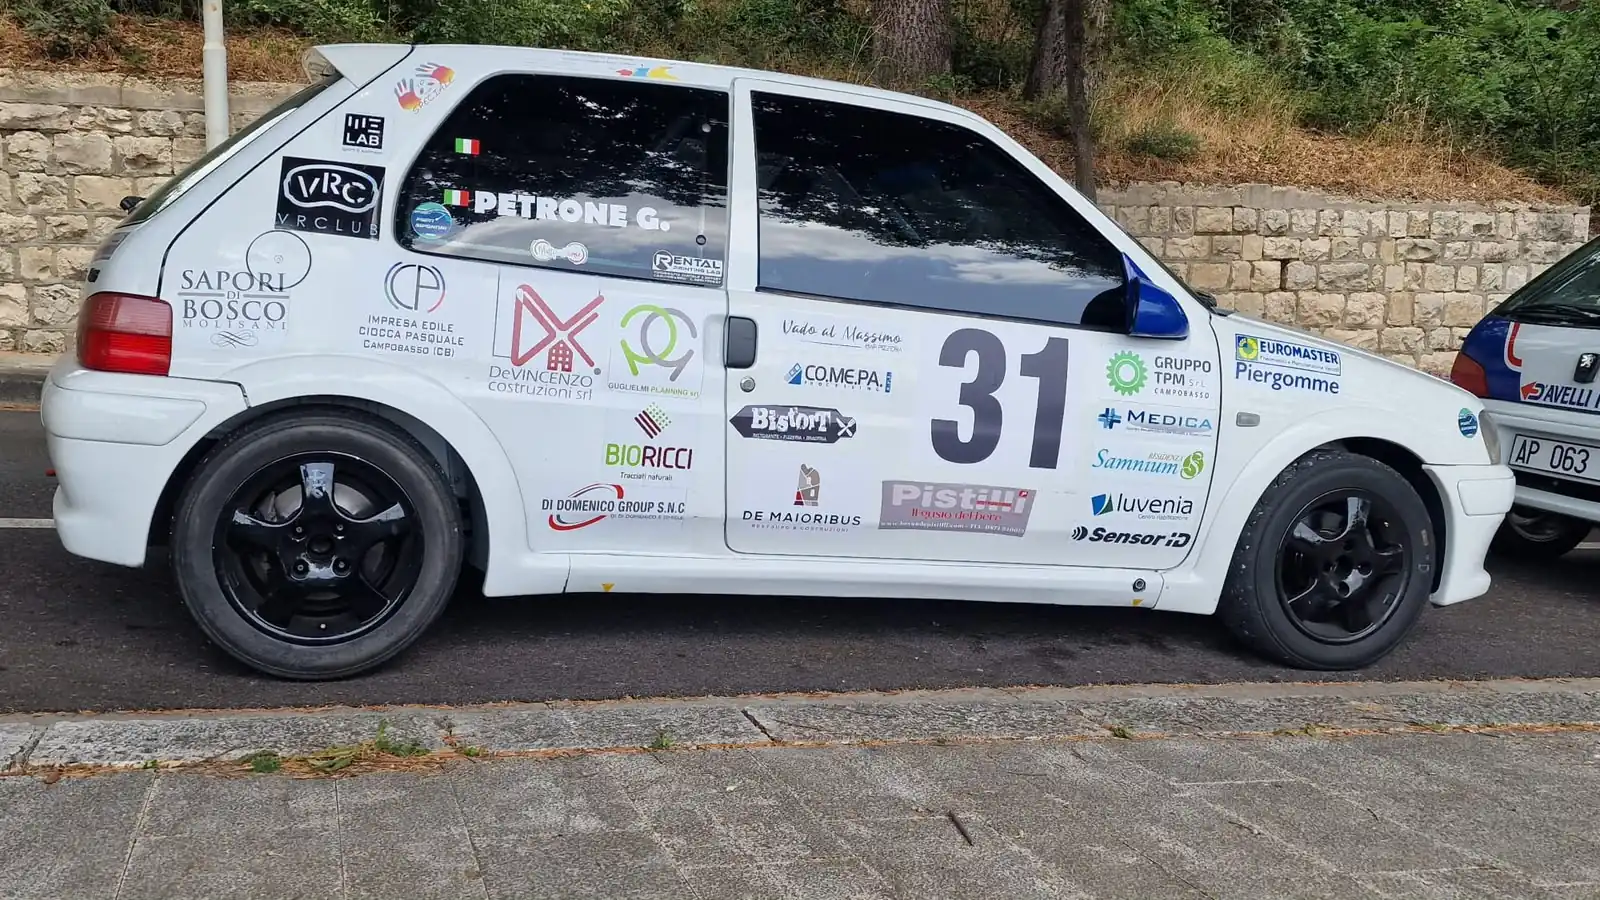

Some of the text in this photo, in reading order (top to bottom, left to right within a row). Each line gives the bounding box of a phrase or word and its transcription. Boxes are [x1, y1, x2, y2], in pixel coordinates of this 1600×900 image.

[346, 132, 380, 146] LAB
[298, 171, 366, 204] VRC
[474, 190, 628, 228] PETRONE
[636, 207, 671, 232] G.
[276, 212, 379, 236] VRCLUB
[655, 253, 721, 269] RENTAL
[180, 268, 285, 293] SAPORI
[226, 289, 241, 300] DI
[182, 300, 286, 322] BOSCO
[182, 319, 288, 331] MOLISANI
[367, 314, 455, 333] IMPRESA EDILE
[783, 319, 902, 344] Vado al Massimo
[358, 326, 465, 346] CIOCCA PASQUALE
[432, 346, 456, 358] (CB)
[1260, 341, 1338, 364] EUROMASTER
[1154, 356, 1212, 373] GRUPPO
[489, 365, 593, 388] DeVINCENZO
[1154, 372, 1185, 386] TPM
[1235, 361, 1340, 394] Piergomme
[488, 378, 593, 401] costruzioni srl
[608, 382, 650, 393] GUGLIELMI
[650, 385, 688, 396] PLANNING
[931, 328, 1069, 469] 31
[1154, 387, 1210, 399] CAMPOBASSO
[1528, 383, 1593, 407] D'AVELLI
[1127, 410, 1212, 430] MEDICA
[605, 443, 693, 470] BIORICCI
[1092, 448, 1178, 475] Samnium
[1515, 439, 1590, 474] AP 063
[620, 471, 673, 481] Tracciati naturali
[541, 499, 554, 510] DI
[556, 499, 615, 512] DOMENICO
[618, 501, 655, 513] GROUP
[893, 483, 1028, 514] Pistilli
[742, 510, 861, 526] DE MAIORIBUS
